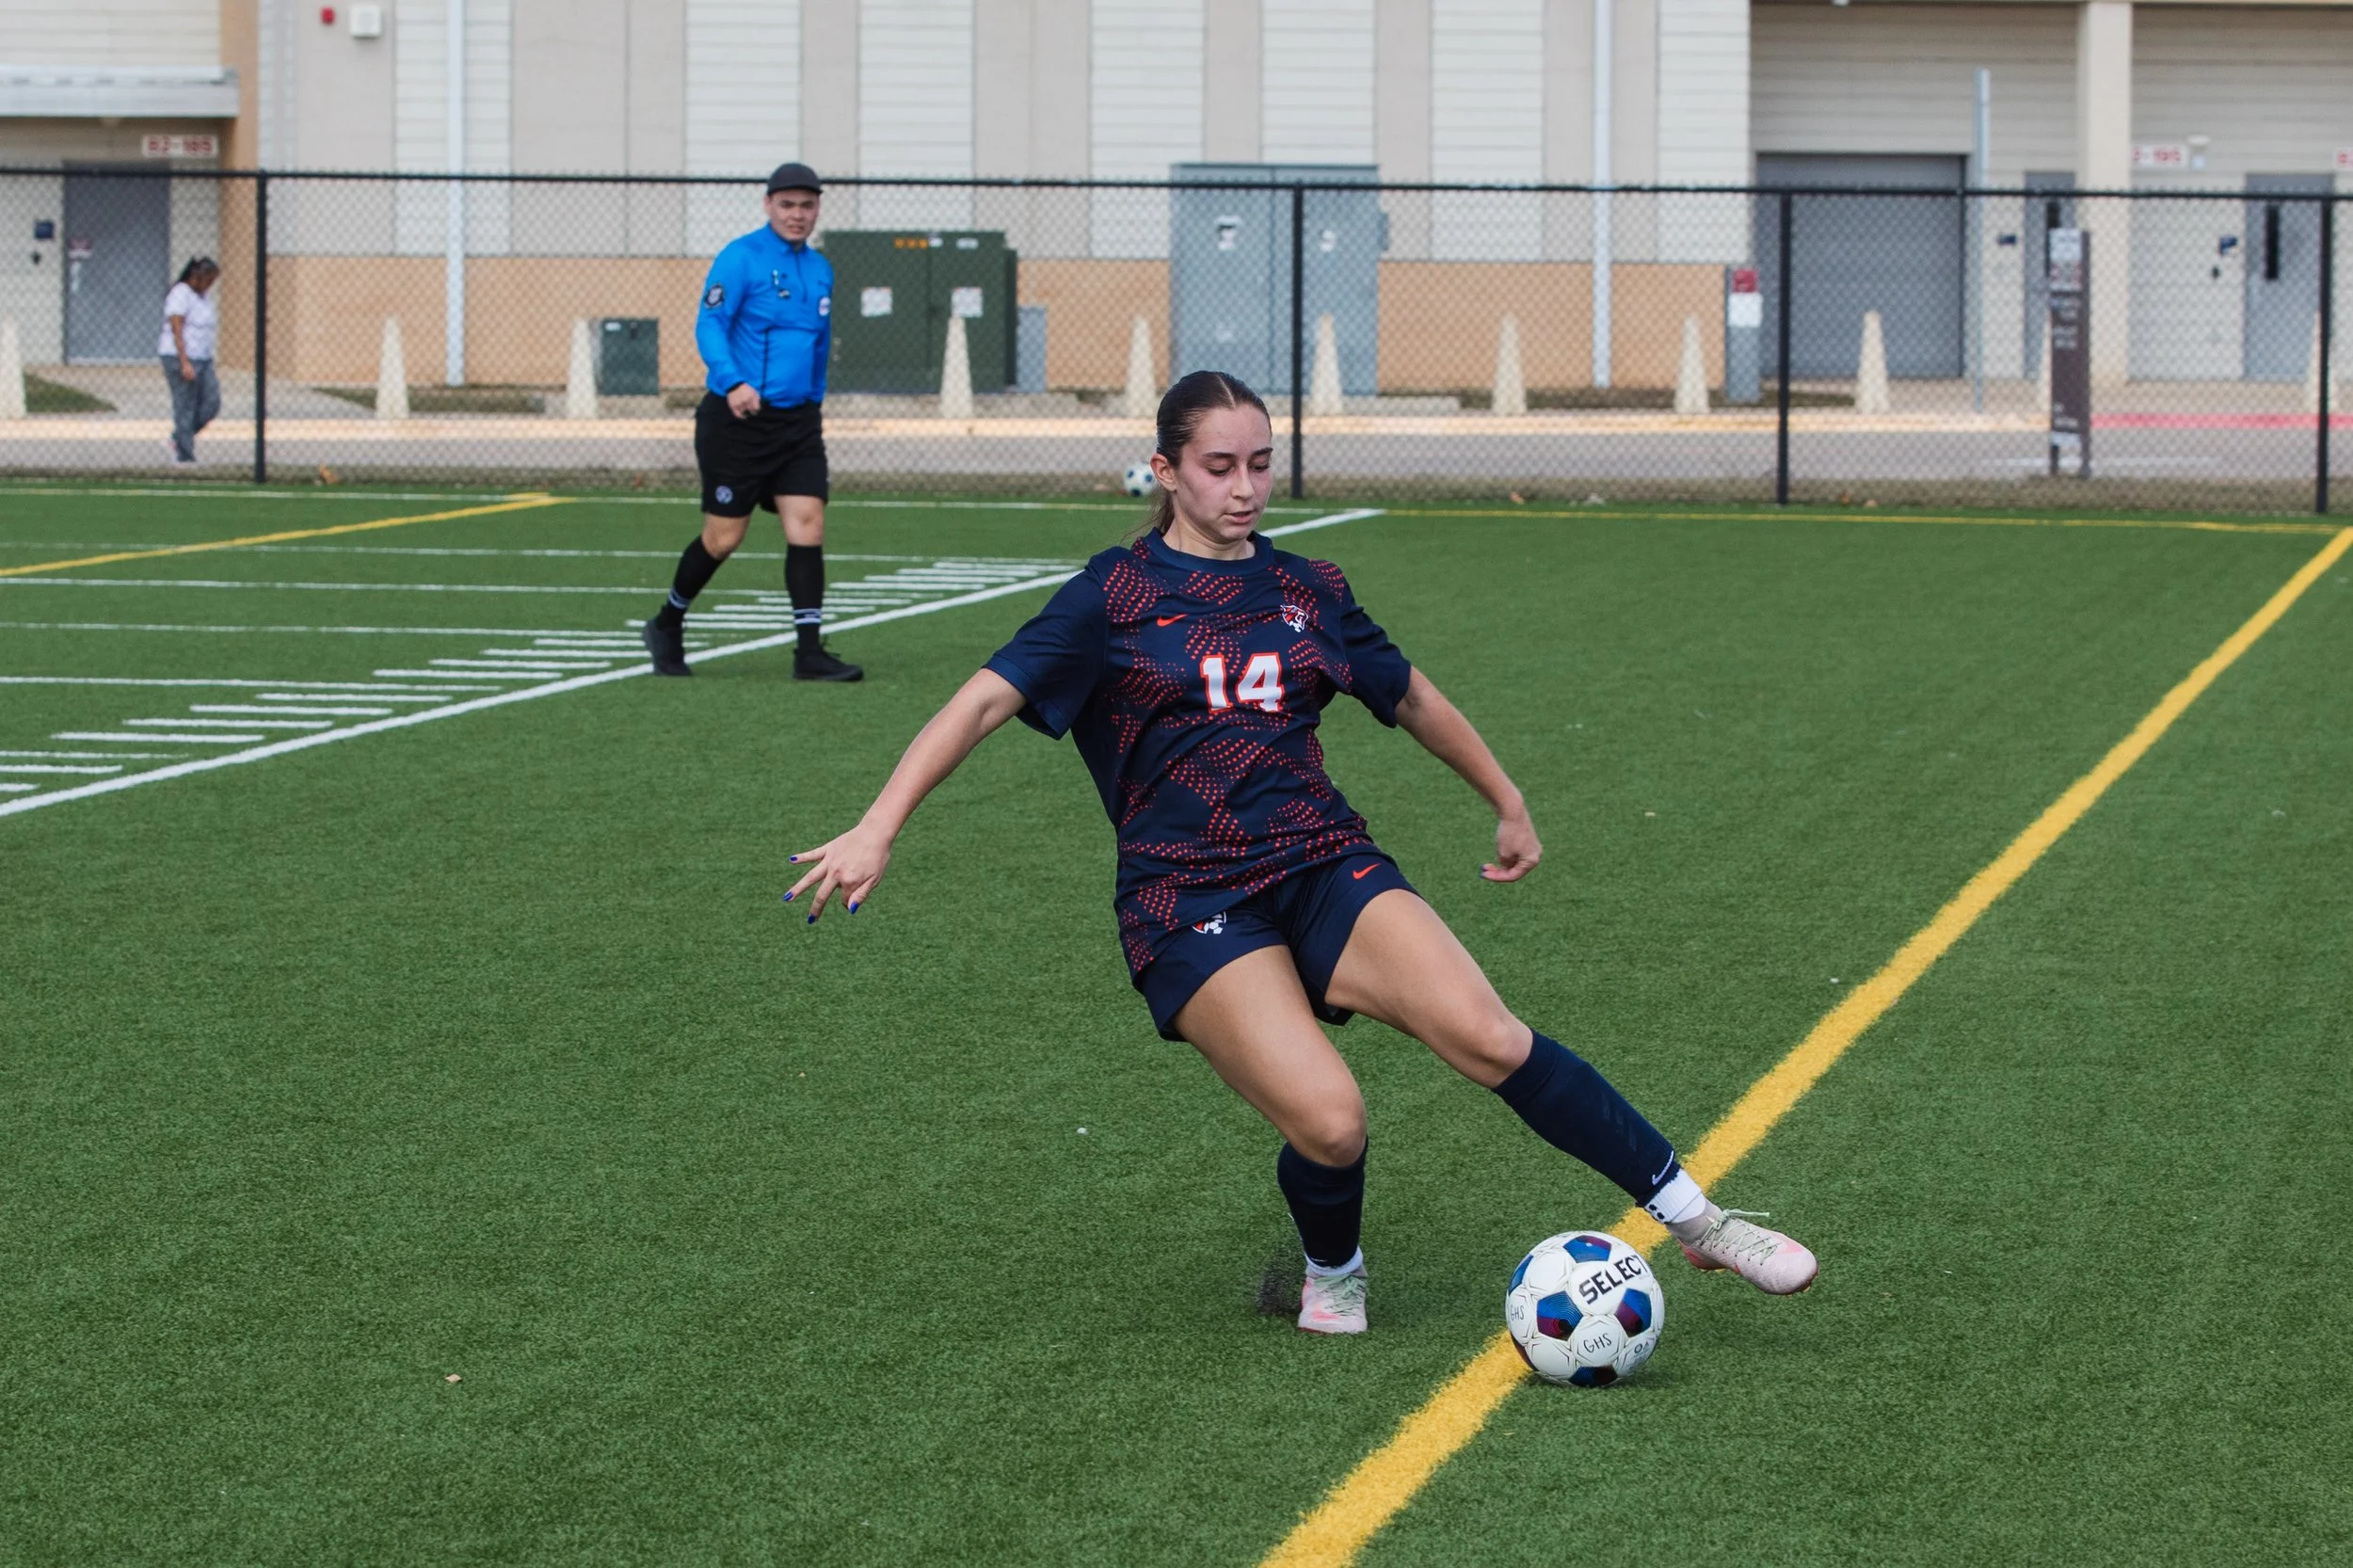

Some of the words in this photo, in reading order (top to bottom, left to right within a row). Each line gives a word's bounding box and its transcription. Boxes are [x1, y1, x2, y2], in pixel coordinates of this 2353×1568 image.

[1200, 651, 1286, 713] 14
[1510, 1304, 1525, 1321] GHS
[1583, 1333, 1612, 1353] GHS
